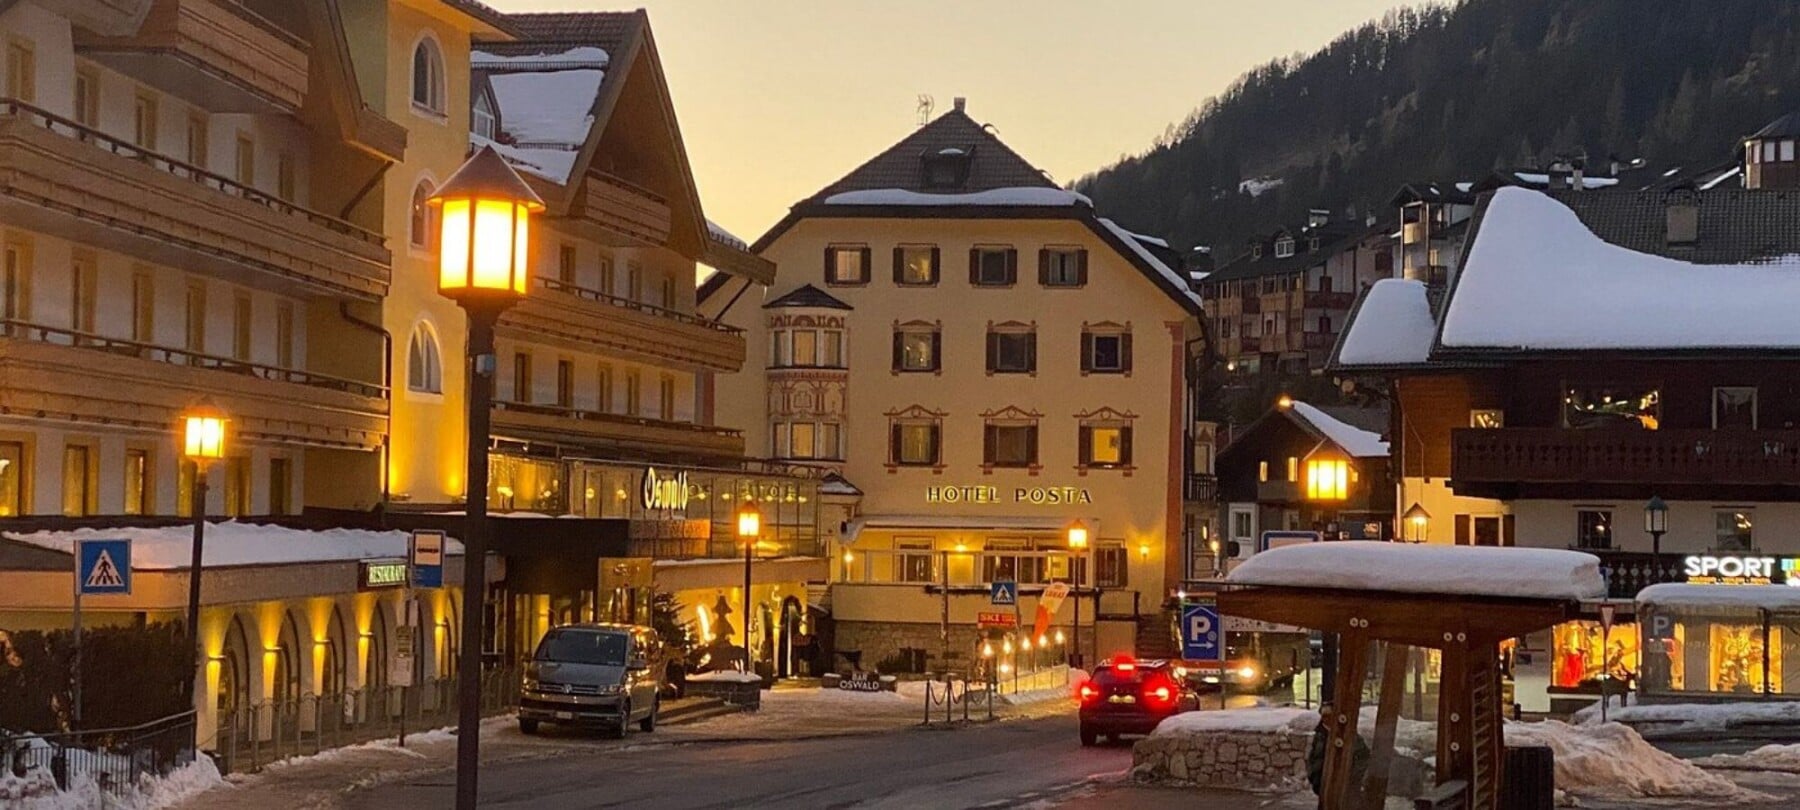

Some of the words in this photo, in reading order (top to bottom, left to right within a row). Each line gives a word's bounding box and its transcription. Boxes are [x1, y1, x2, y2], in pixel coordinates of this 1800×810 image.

[644, 466, 688, 511] Oswald
[927, 486, 1001, 503] HOTEL
[1014, 487, 1092, 504] POSTA
[1684, 556, 1775, 577] SPORT
[1191, 616, 1211, 641] P
[1653, 616, 1669, 636] P
[840, 680, 880, 690] OSWALD
